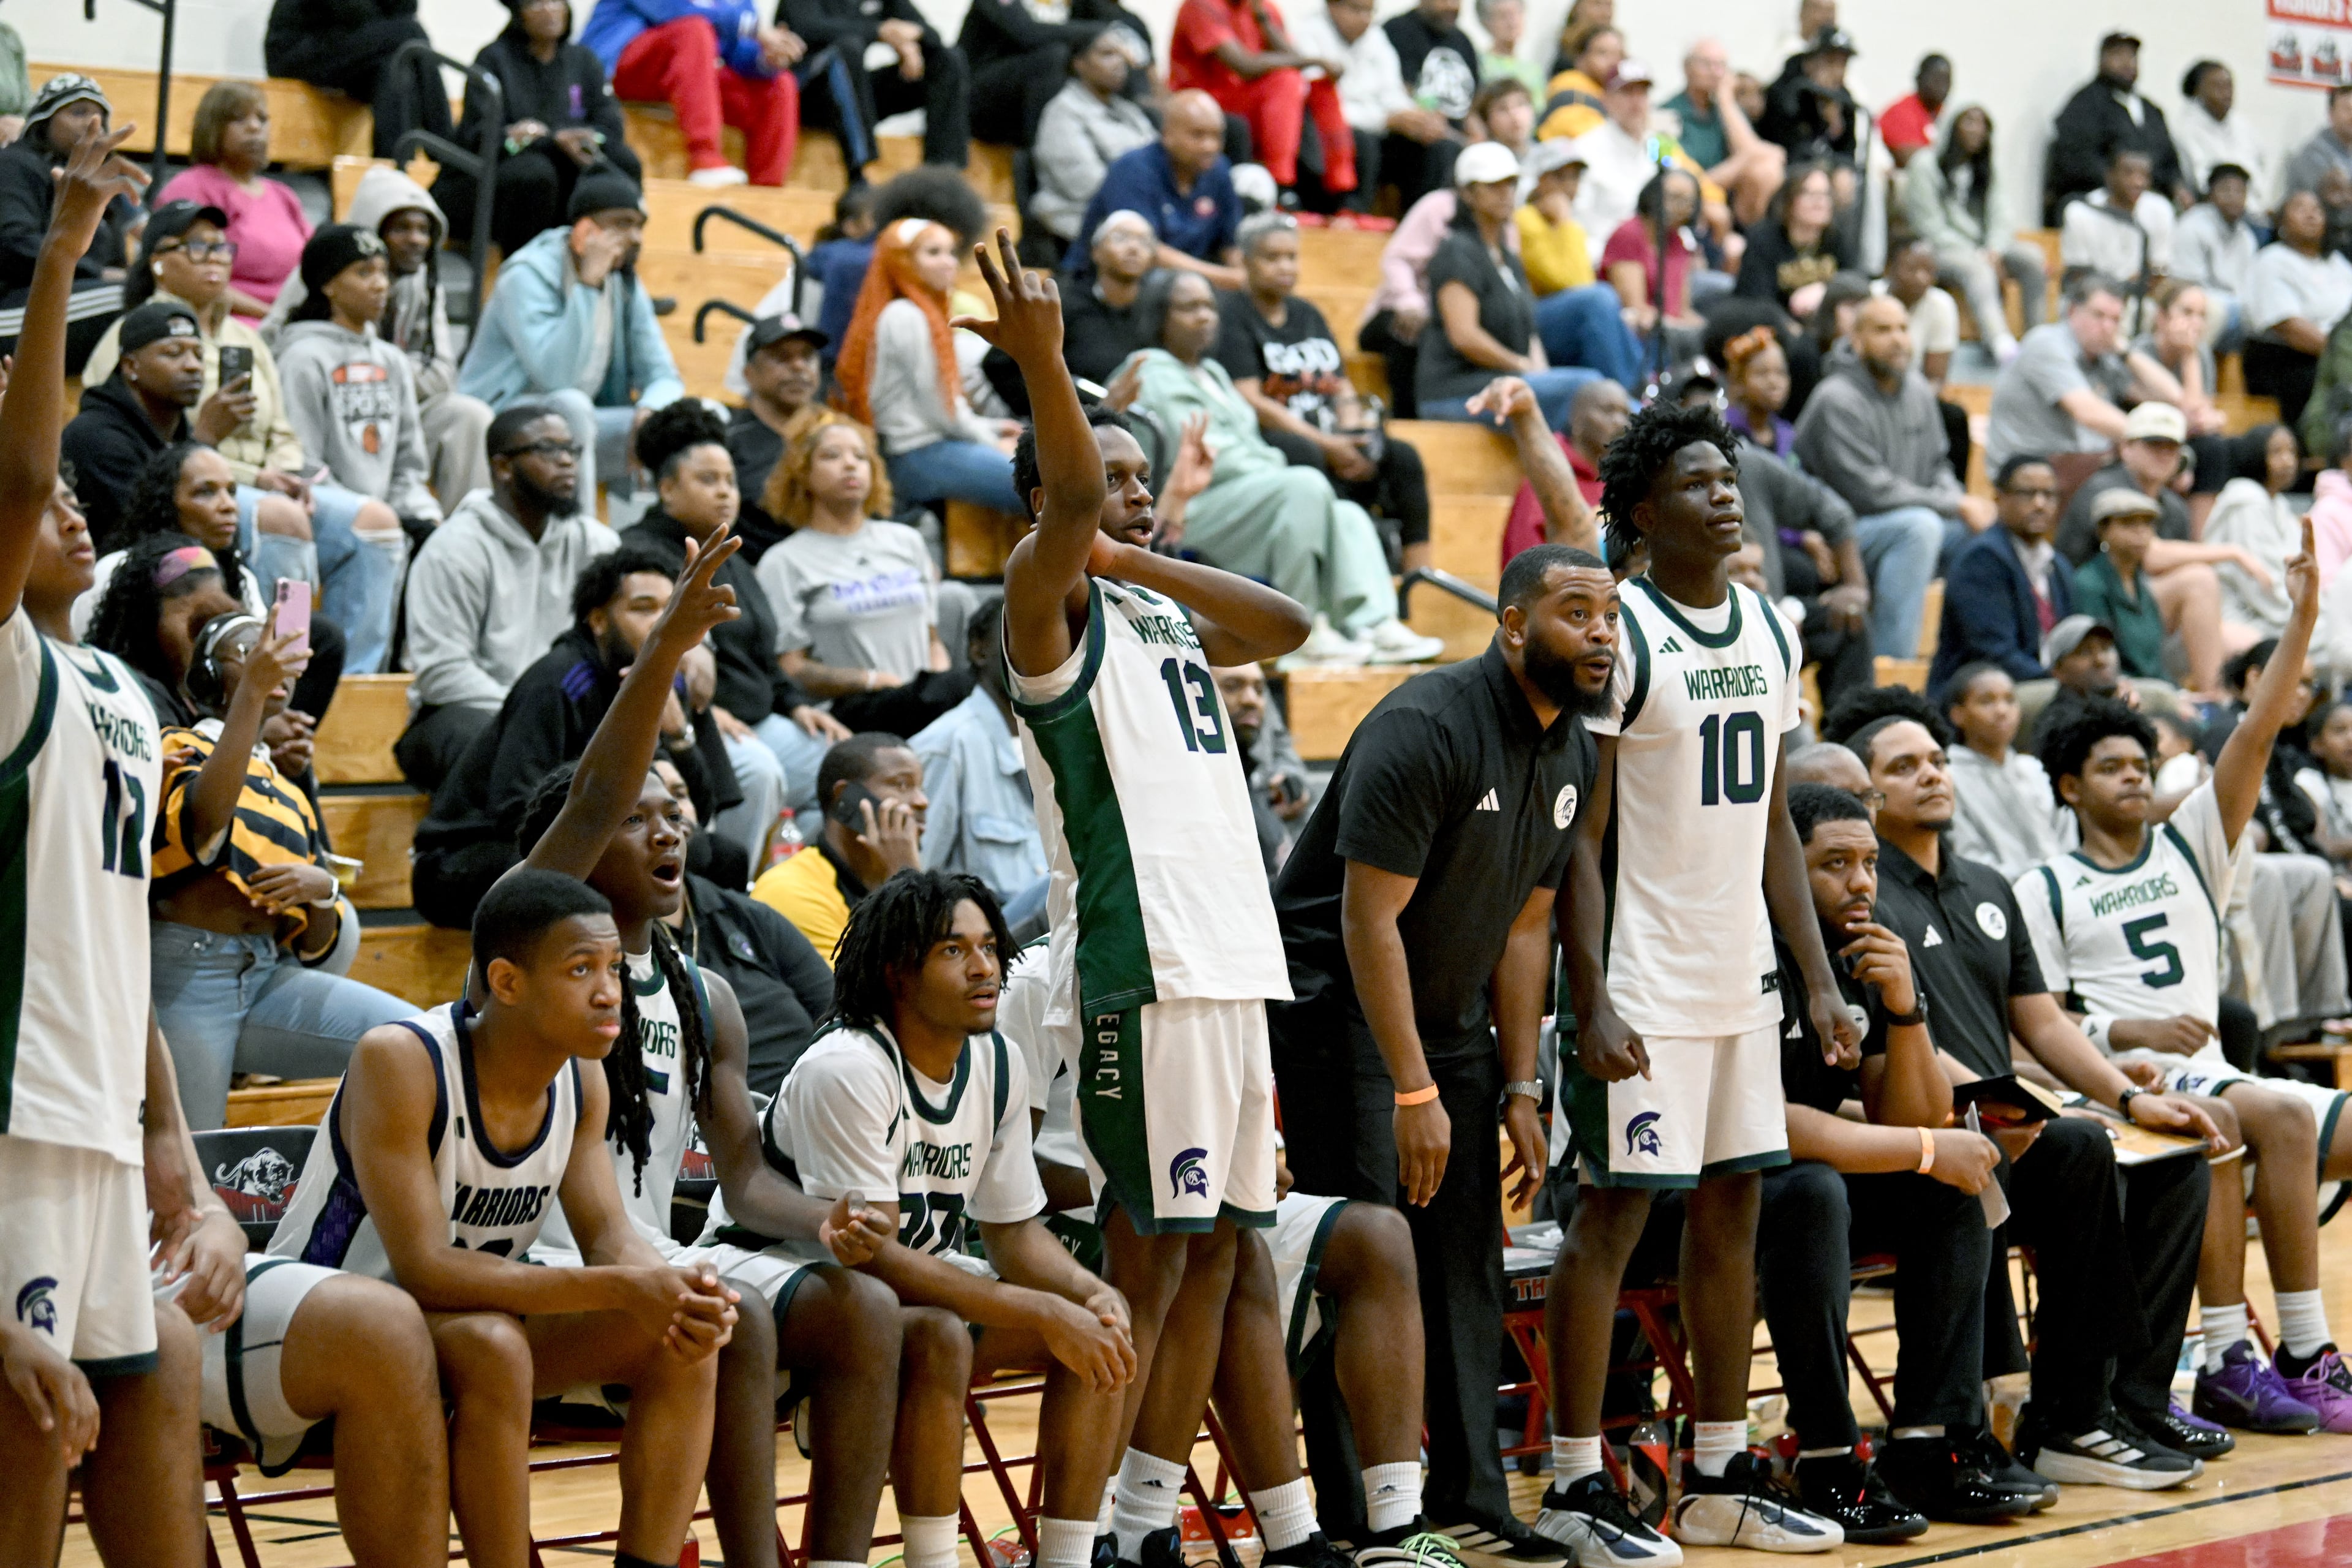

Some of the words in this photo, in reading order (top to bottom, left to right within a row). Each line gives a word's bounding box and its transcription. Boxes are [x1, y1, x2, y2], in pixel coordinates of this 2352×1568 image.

[1160, 658, 1226, 754] 13
[1684, 665, 1768, 700] WARRIORS
[1699, 711, 1765, 806] 10
[2089, 872, 2179, 917] WARRIORS
[2121, 912, 2185, 989] 5
[1095, 1014, 1122, 1099] EGACY
[1510, 1275, 1549, 1301] TH
